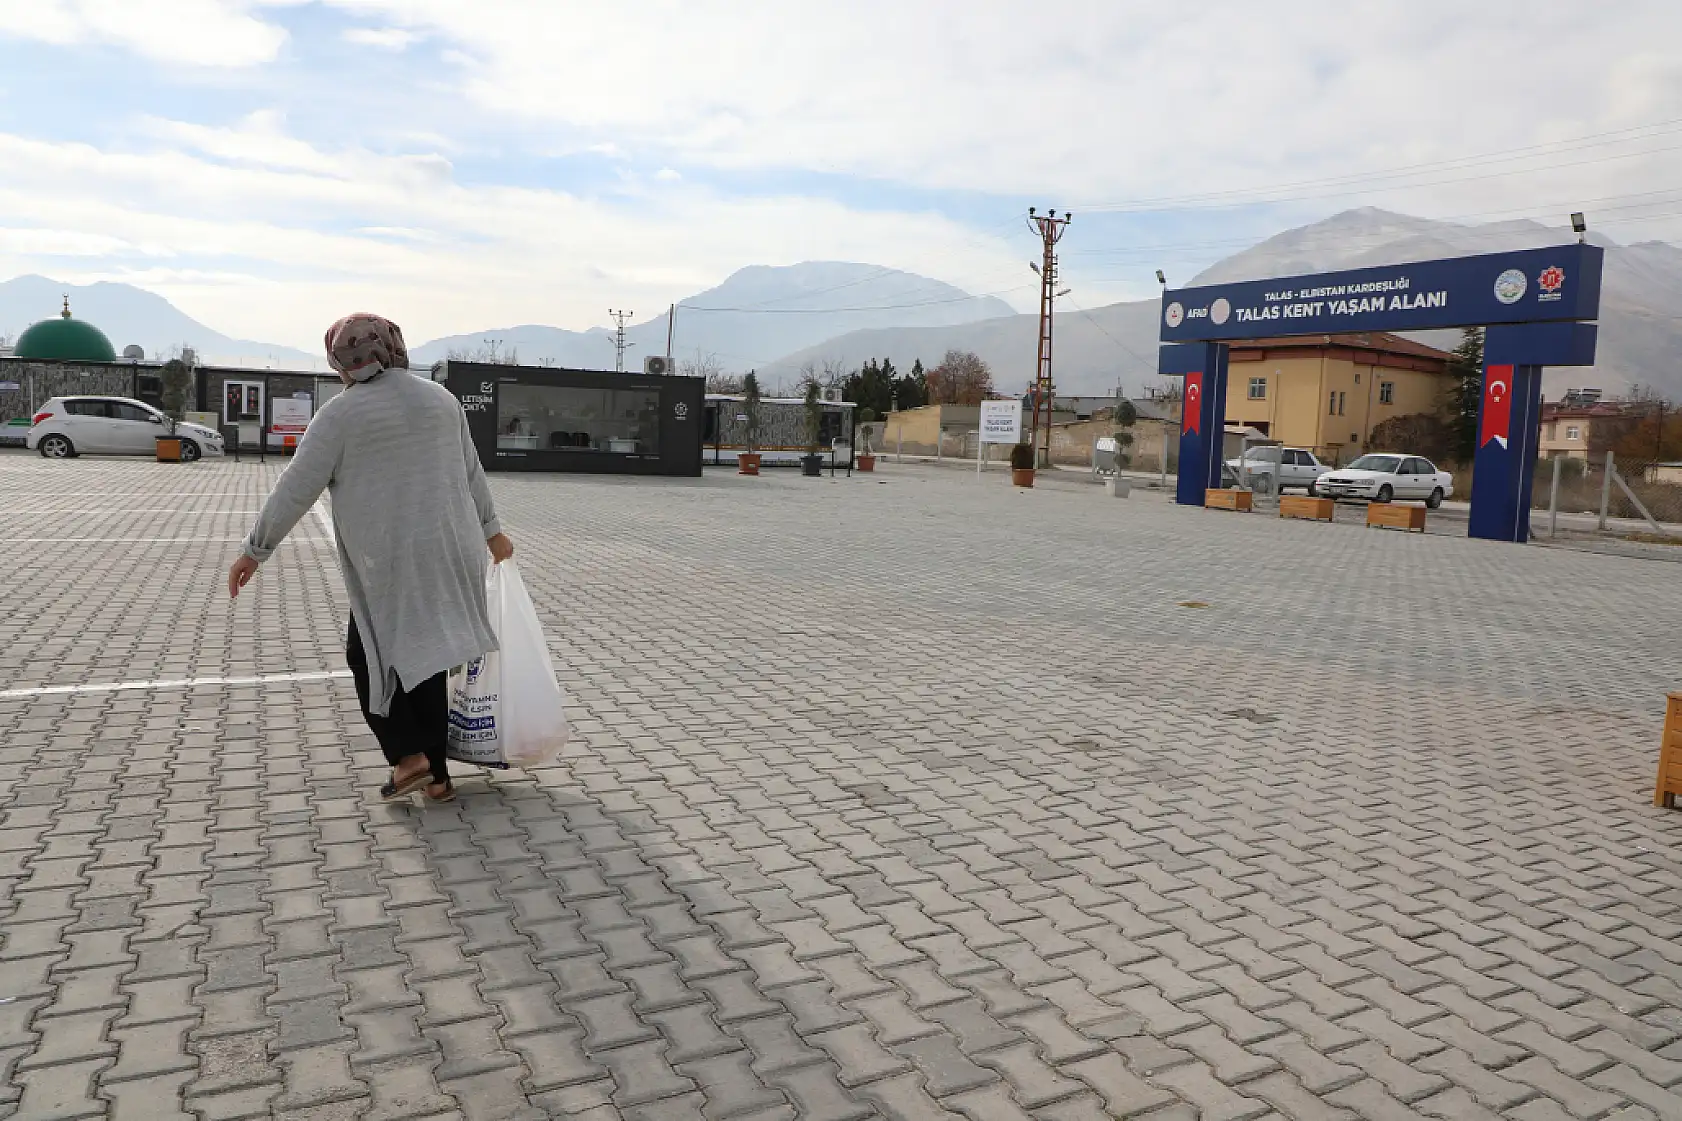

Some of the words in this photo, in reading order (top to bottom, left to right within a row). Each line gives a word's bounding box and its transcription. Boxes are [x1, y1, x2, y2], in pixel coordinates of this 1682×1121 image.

[1264, 290, 1293, 302] TALAS
[1235, 304, 1281, 323] TALAS
[1283, 300, 1325, 319] KENT
[1327, 295, 1386, 316] YAŞAM
[1388, 290, 1448, 311] ALANI
[1186, 307, 1209, 319] AFAD
